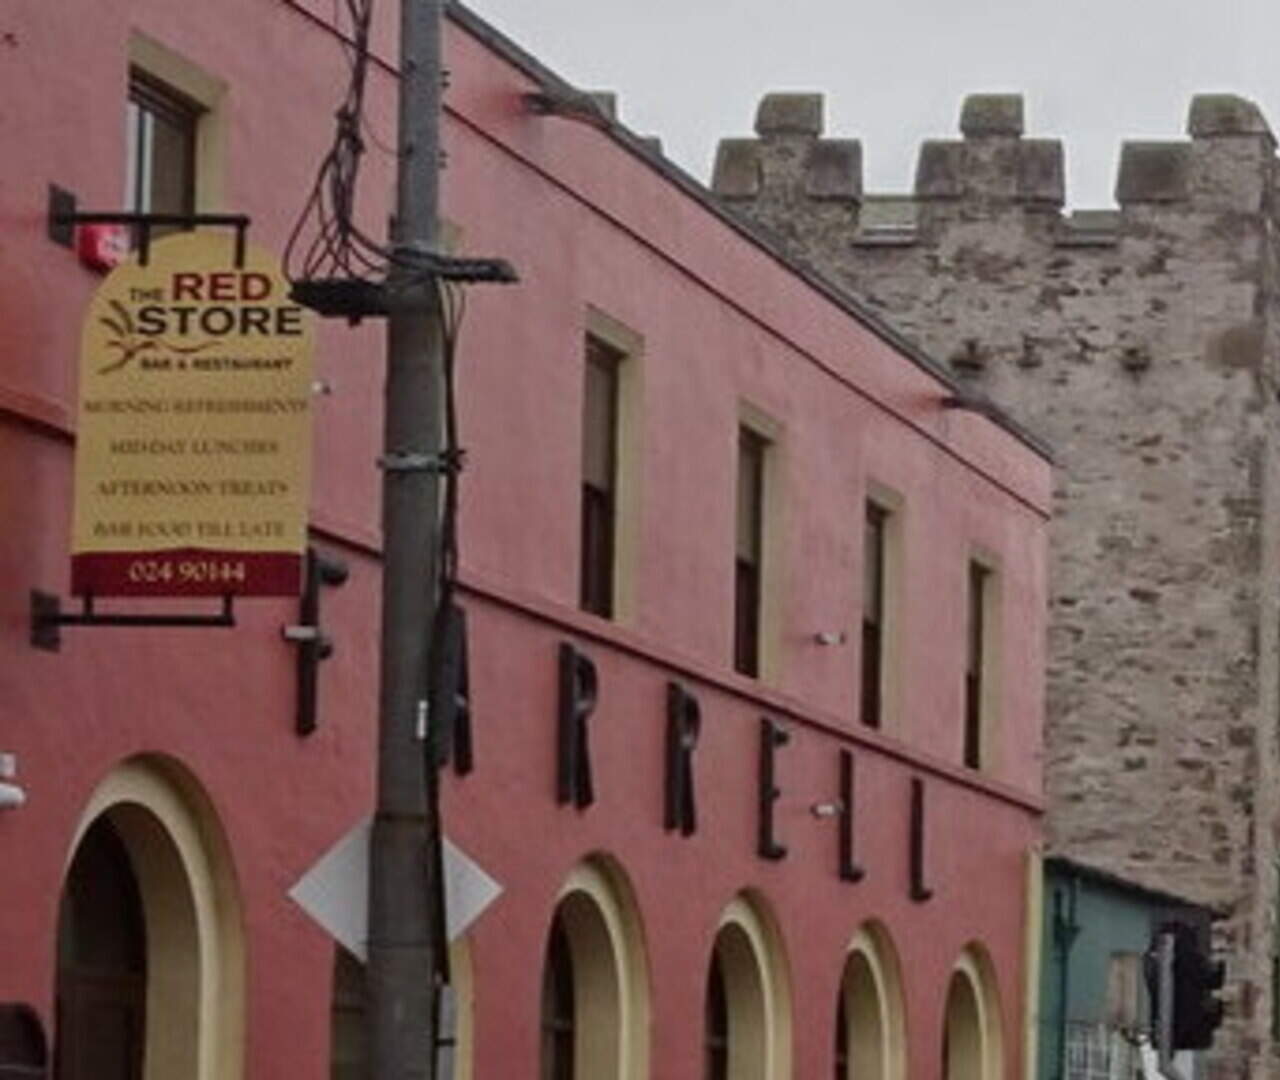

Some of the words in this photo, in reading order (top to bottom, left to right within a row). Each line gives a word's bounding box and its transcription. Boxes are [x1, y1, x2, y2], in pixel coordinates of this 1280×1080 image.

[131, 288, 164, 301] THE
[172, 272, 272, 302] RED
[136, 305, 303, 336] STORE
[141, 358, 173, 371] BAR
[178, 359, 187, 370] &
[193, 357, 294, 371] RESTAURANT
[83, 400, 168, 414] MORNING
[172, 399, 309, 414] REFRESHMENTS
[191, 439, 279, 454] LUNCHES
[98, 480, 212, 496] AFTERNOON
[219, 480, 289, 496] TREATS
[93, 520, 132, 537] BAR
[138, 520, 192, 537] FOOD
[196, 520, 231, 537] TILL
[238, 520, 285, 537] LATE
[128, 561, 174, 582] 024
[178, 561, 246, 582] 90144
